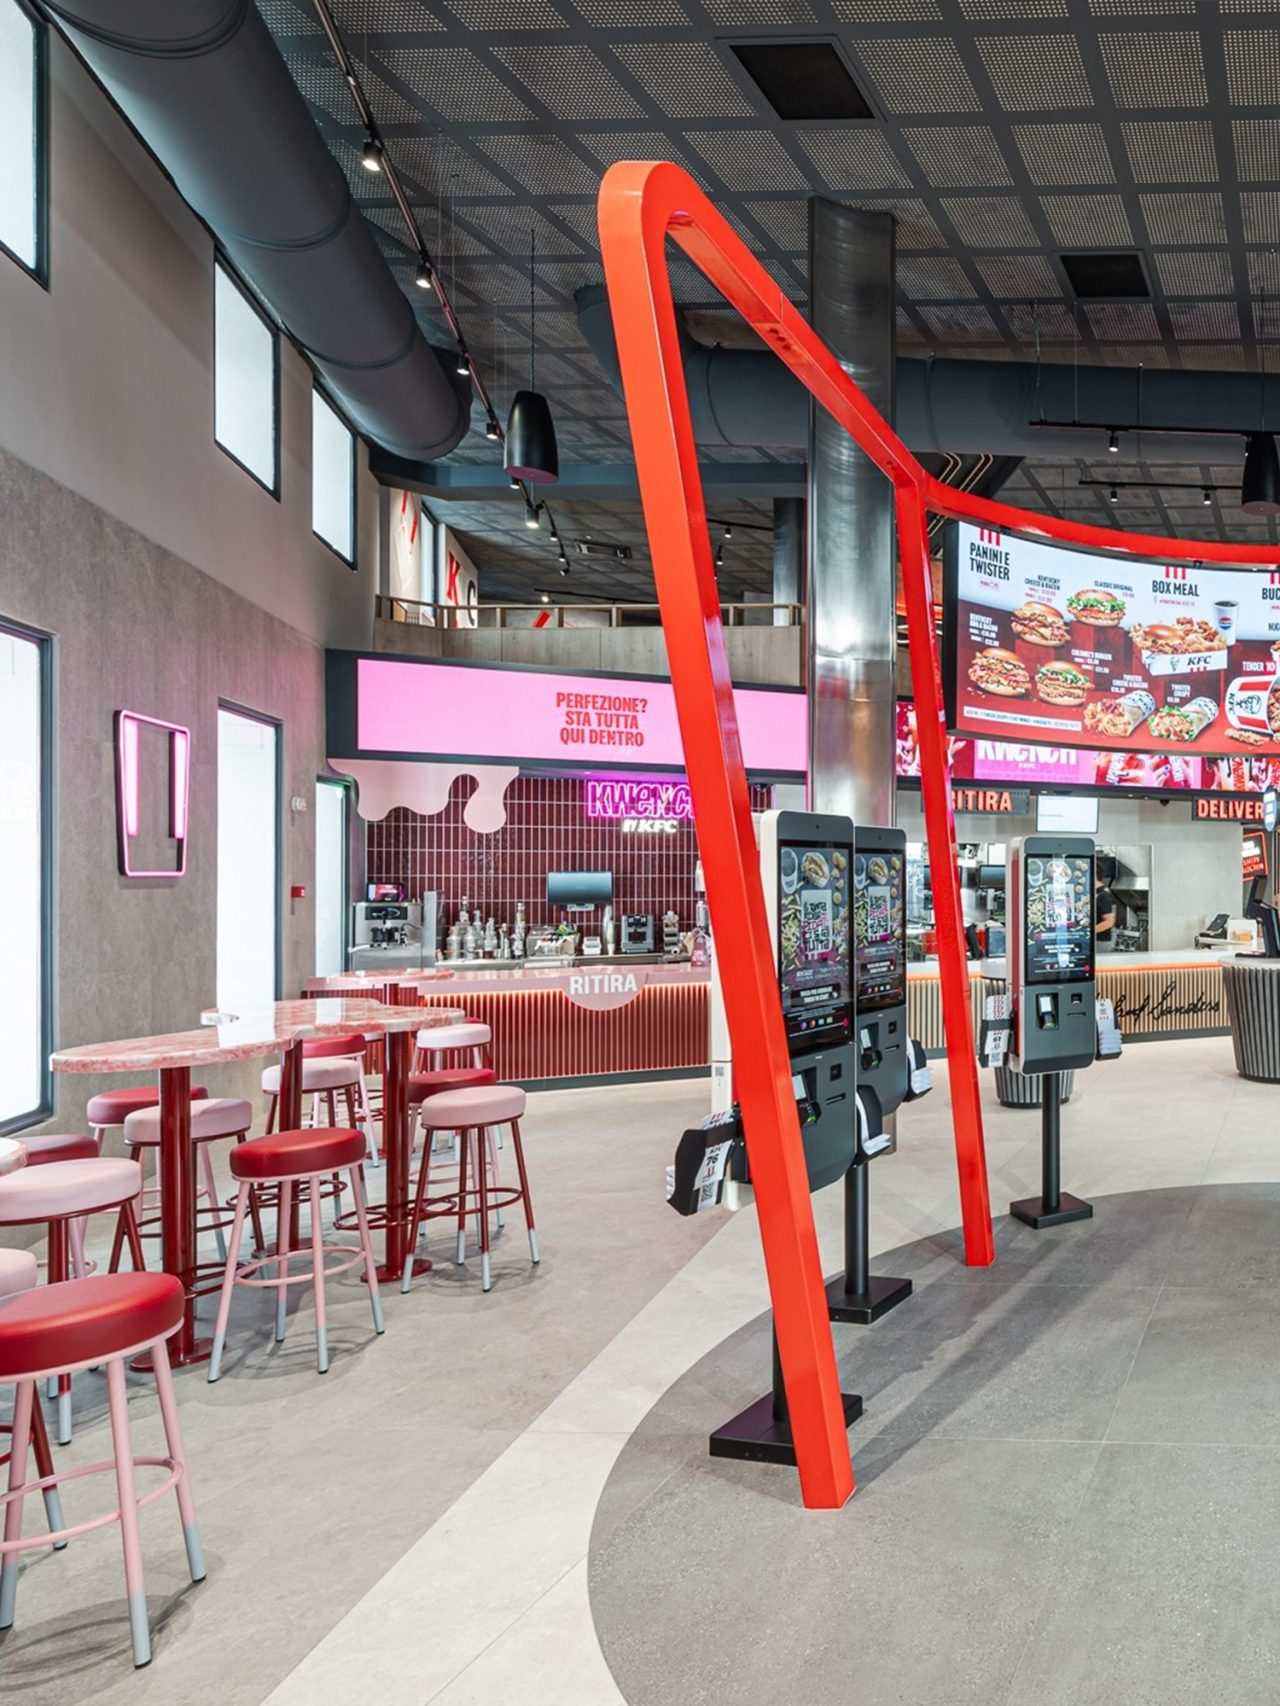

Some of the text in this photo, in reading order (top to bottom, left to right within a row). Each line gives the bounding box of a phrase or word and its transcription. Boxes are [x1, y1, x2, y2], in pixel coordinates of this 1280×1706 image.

[970, 542, 1011, 567] PANINI E
[970, 558, 1011, 581] TWISTER
[1152, 580, 1200, 597] BOX MEAL
[1187, 656, 1212, 667] KFC
[556, 692, 648, 713] PERFEZIONE?
[565, 710, 639, 729] STA TUTTA
[560, 727, 644, 747] QUI DENTRO
[1198, 799, 1264, 819] DELIVER
[638, 819, 678, 833] KFC
[570, 973, 637, 995] RITIRA
